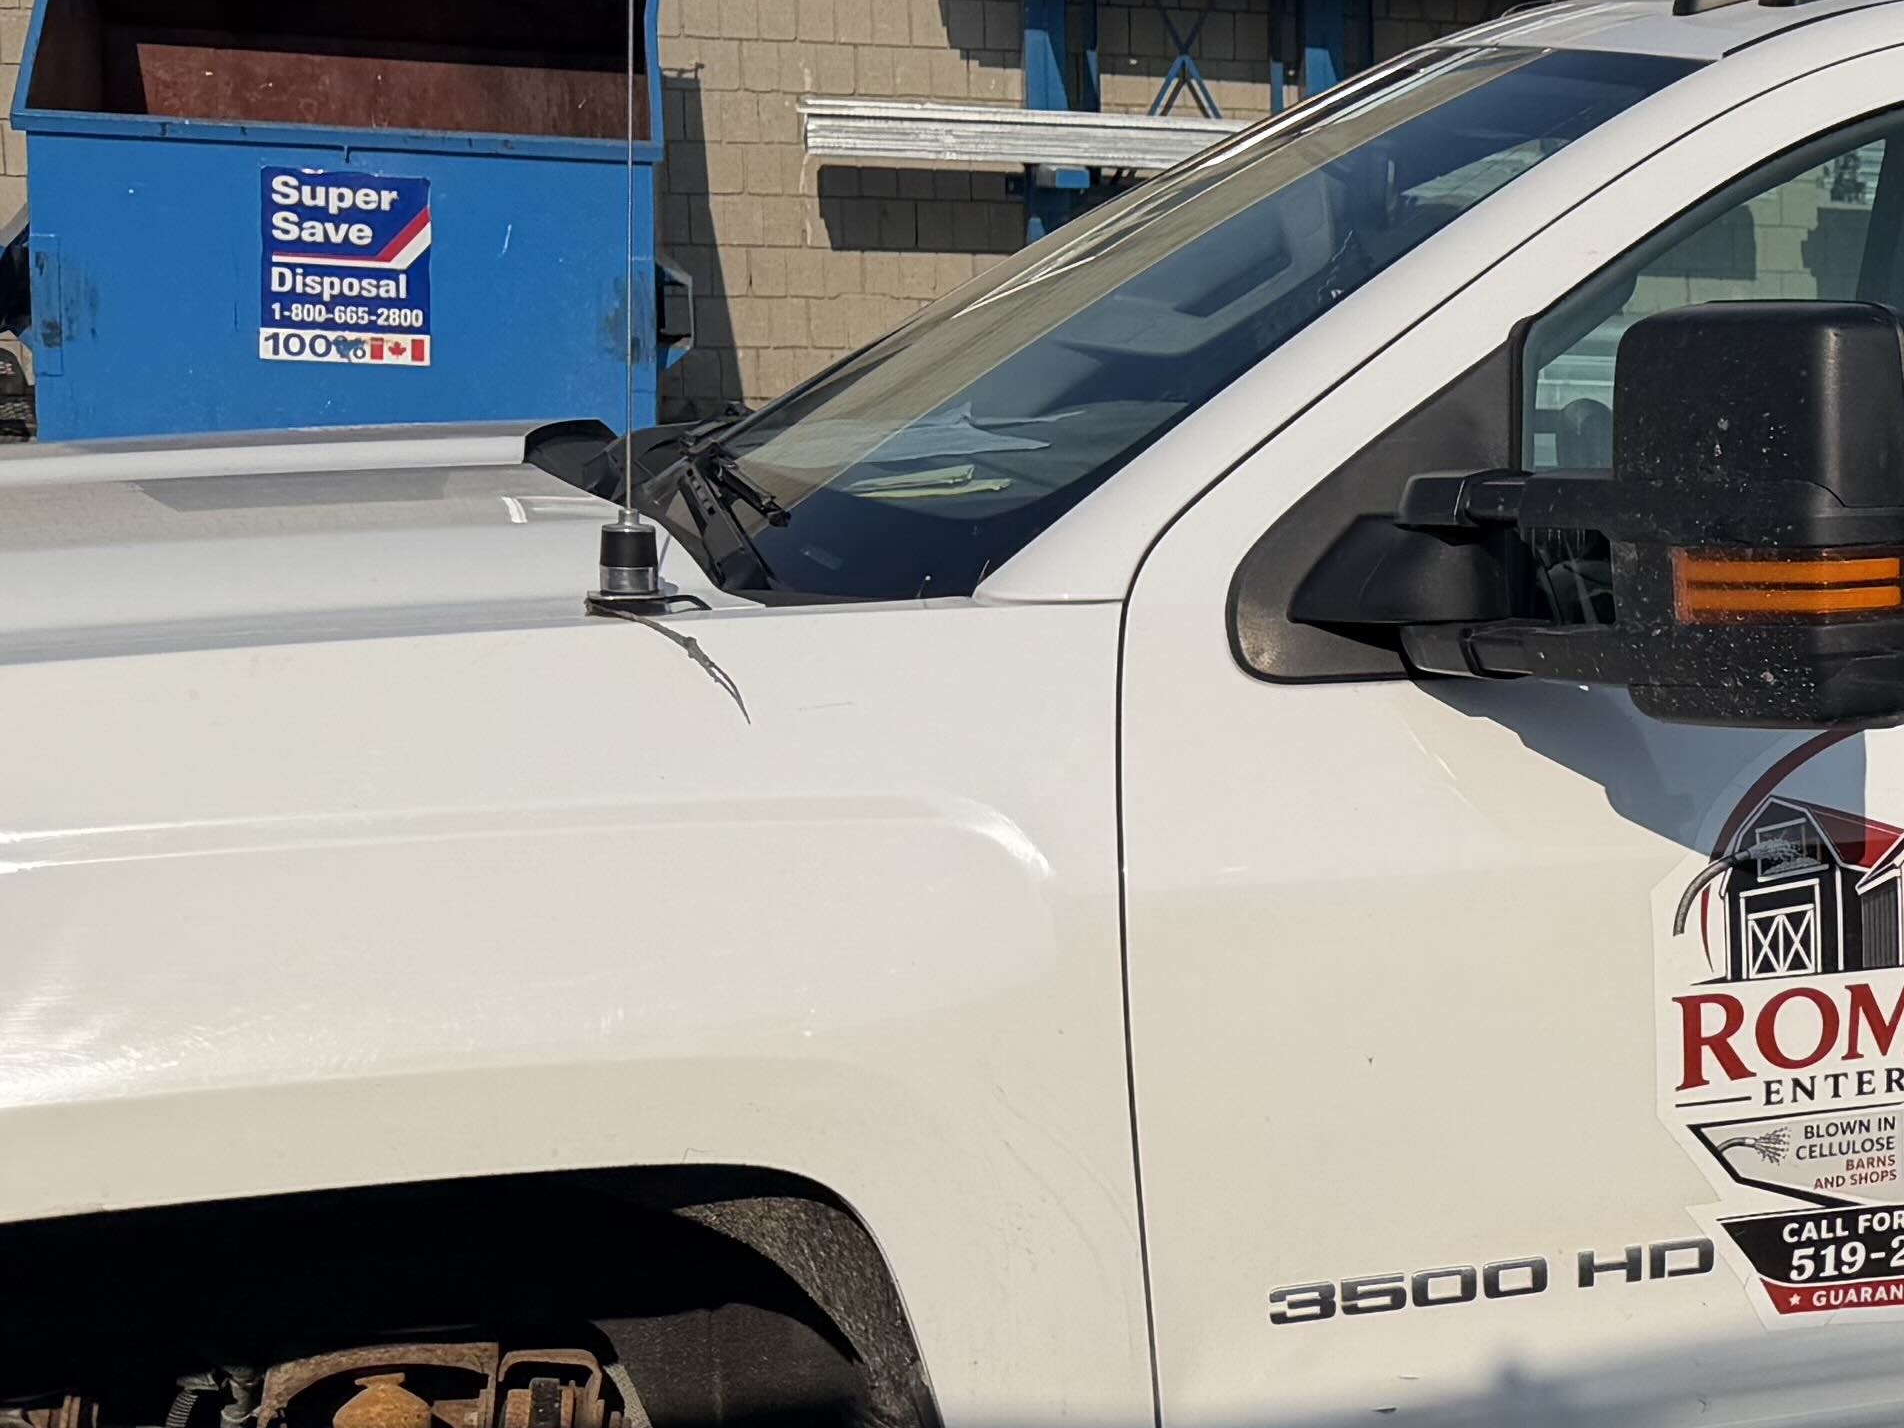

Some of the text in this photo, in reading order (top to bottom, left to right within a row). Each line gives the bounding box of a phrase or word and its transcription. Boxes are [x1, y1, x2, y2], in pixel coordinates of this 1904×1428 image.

[271, 175, 399, 214] Super
[271, 211, 373, 245] Save
[271, 266, 407, 302] Disposal
[271, 302, 423, 327] 1-800-665-2800
[1804, 1116, 1896, 1139] BLOWN IN
[1795, 1136, 1896, 1160] CELLULOSE
[1845, 1155, 1896, 1172] BARNS
[1814, 1169, 1897, 1190] AND SHOPS
[1782, 1217, 1849, 1243] CALL
[1269, 1237, 1715, 1325] 3500 HD
